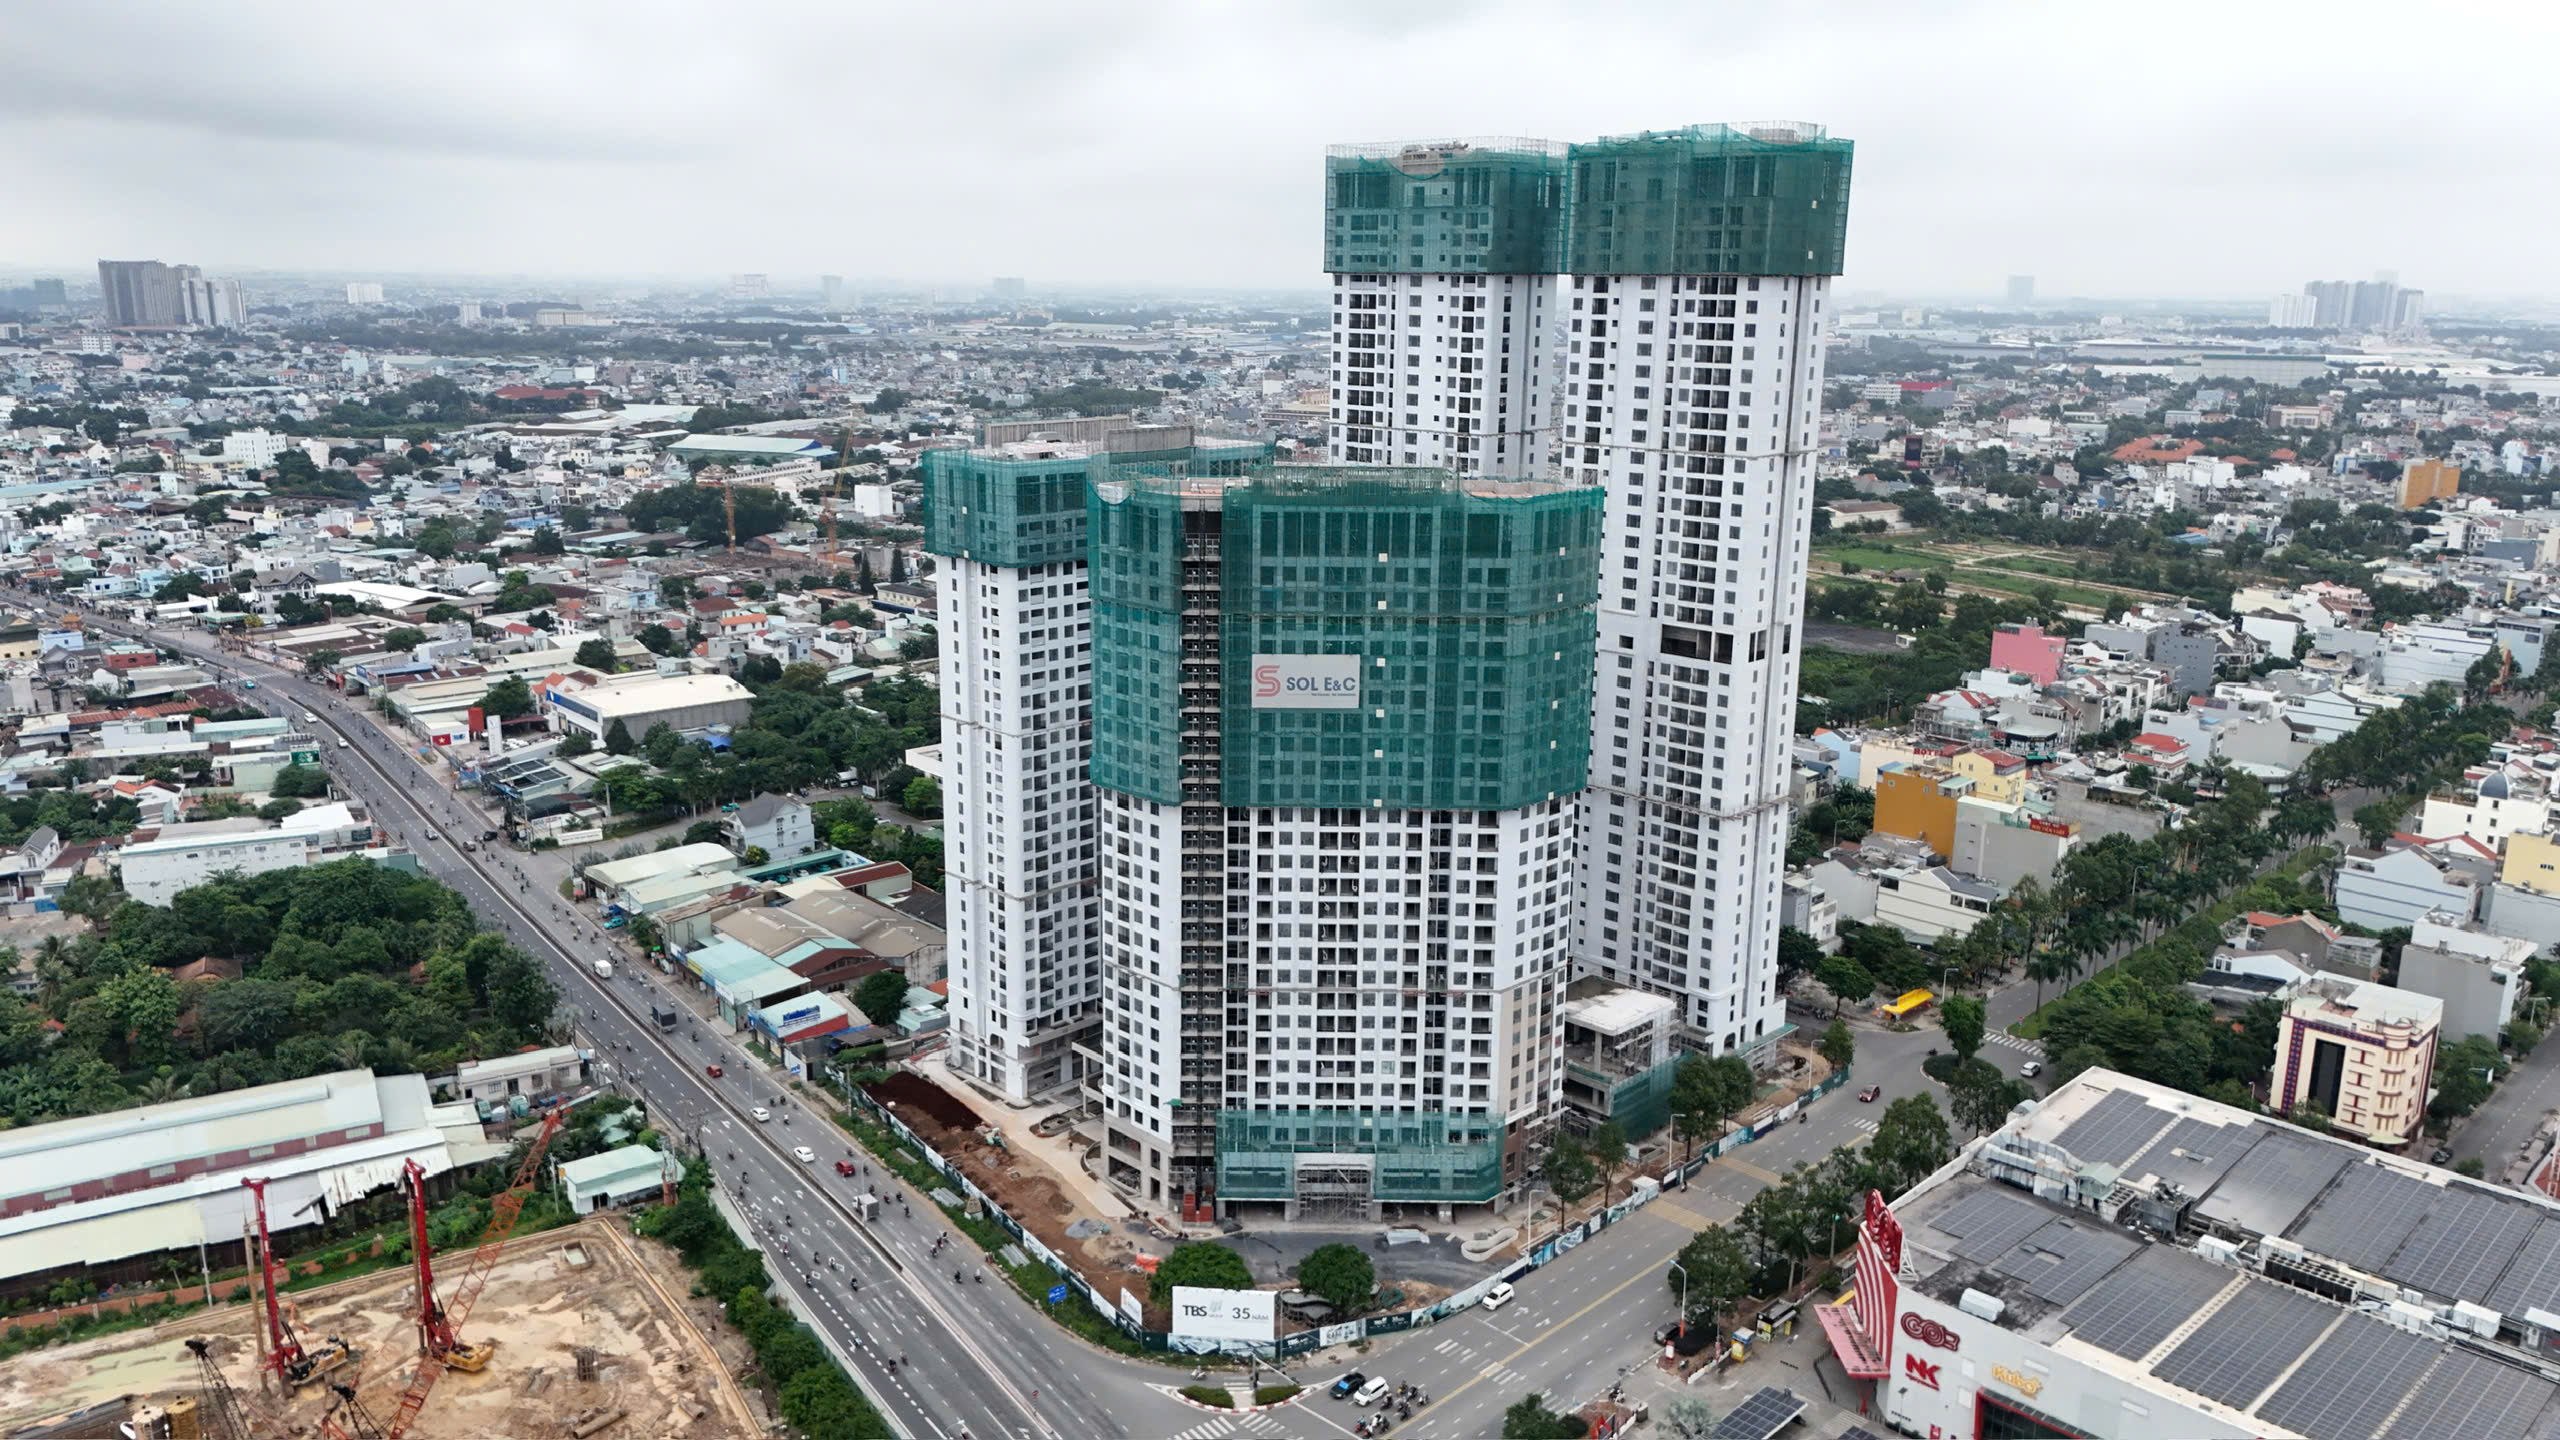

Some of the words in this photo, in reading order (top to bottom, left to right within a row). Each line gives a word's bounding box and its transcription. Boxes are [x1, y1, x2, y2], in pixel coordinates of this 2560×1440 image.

[1286, 676, 1318, 691] SOL
[1324, 676, 1356, 691] E&C
[1182, 1304, 1208, 1317] TBS
[1232, 1307, 1251, 1319] 35
[1906, 1353, 1941, 1386] NK
